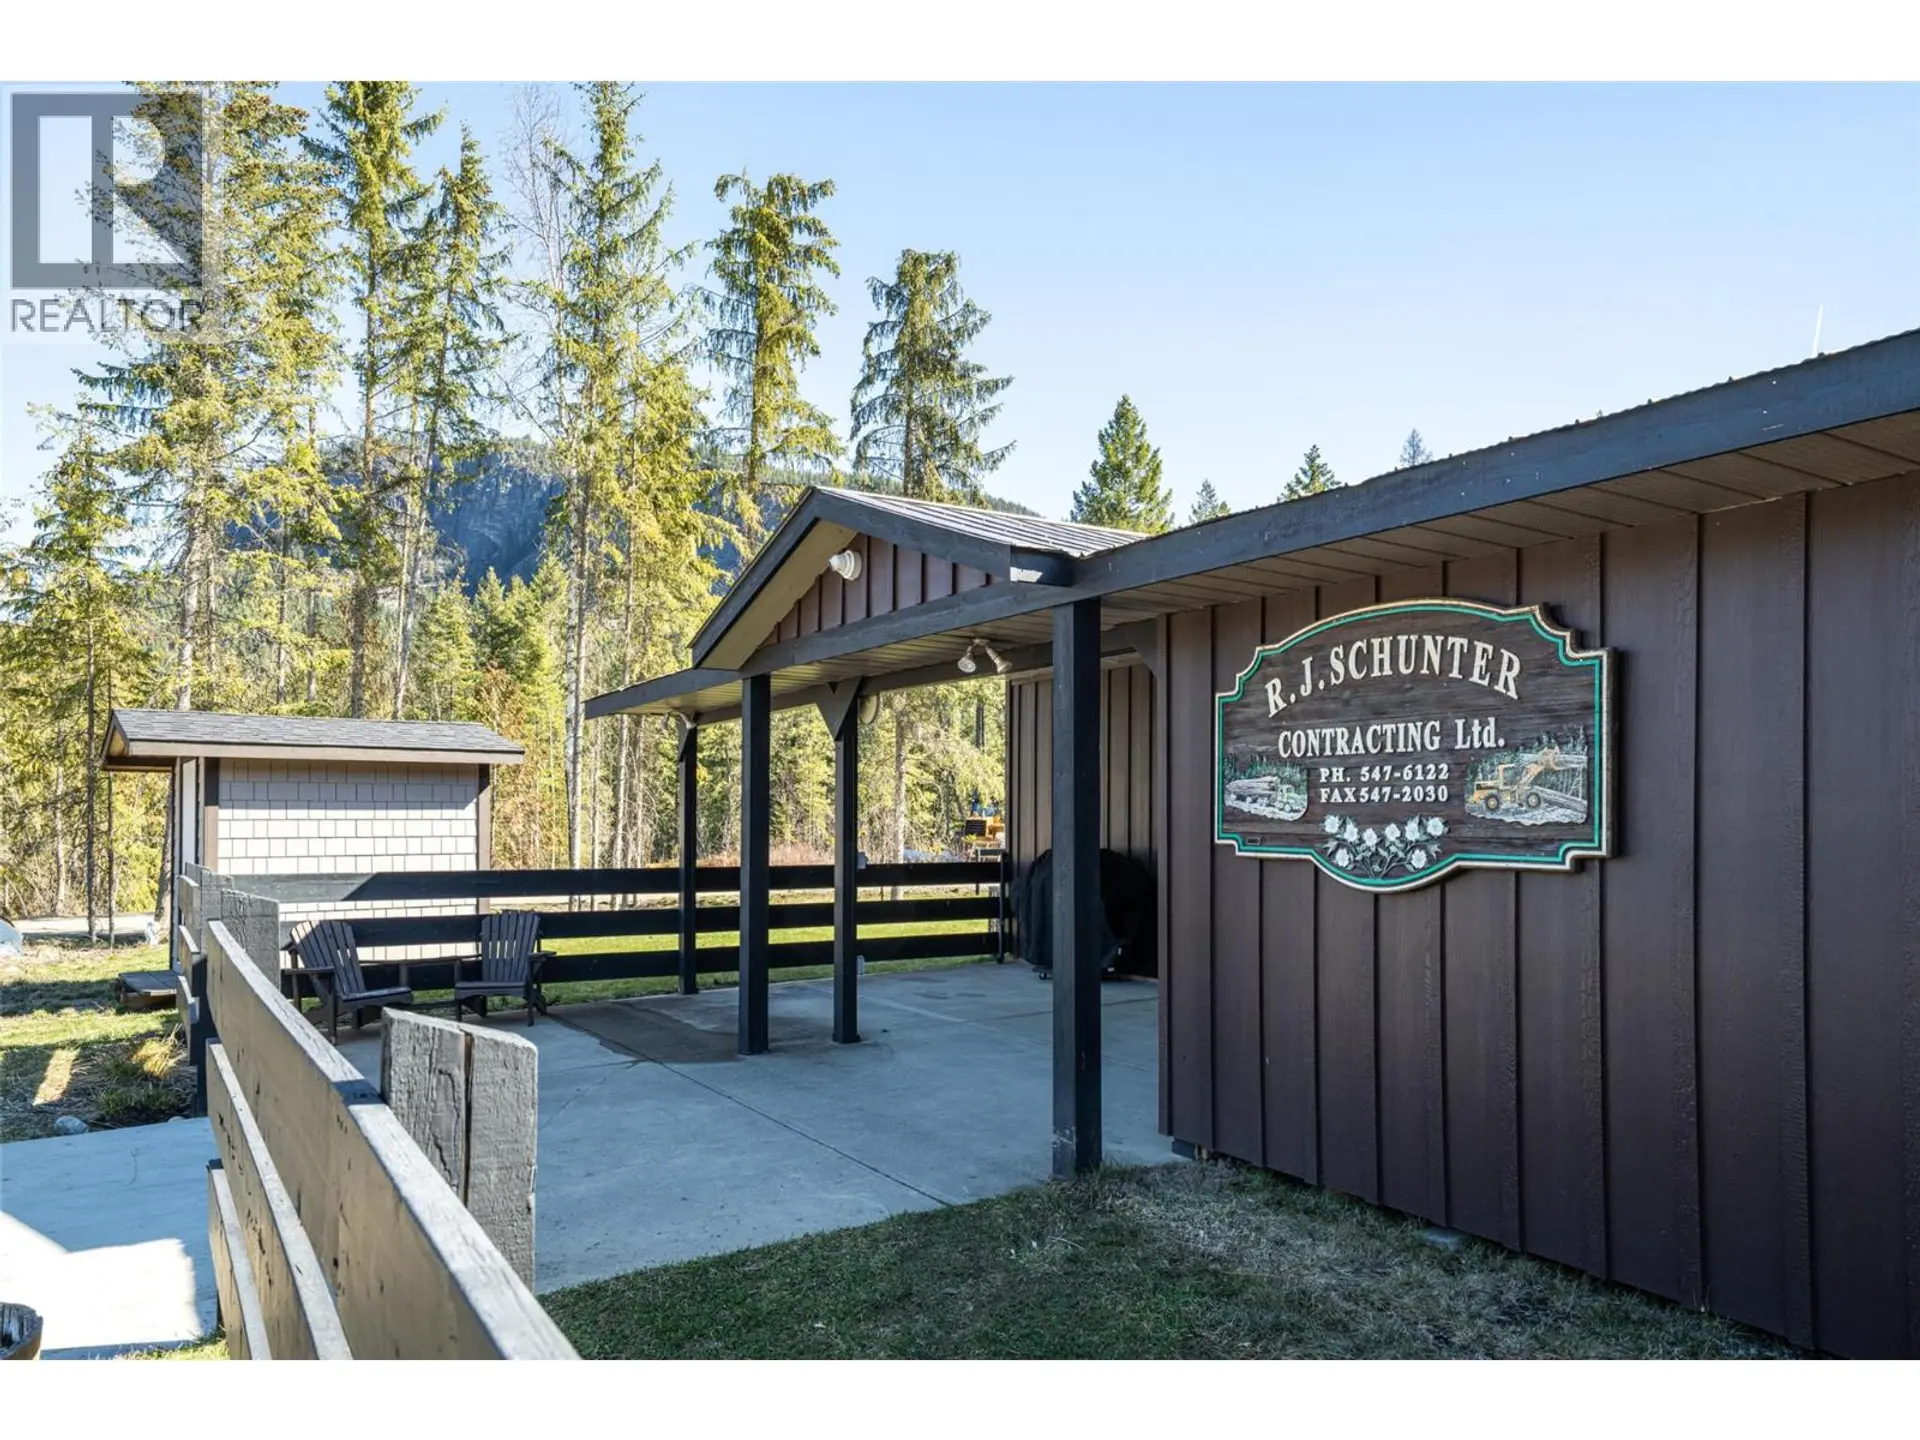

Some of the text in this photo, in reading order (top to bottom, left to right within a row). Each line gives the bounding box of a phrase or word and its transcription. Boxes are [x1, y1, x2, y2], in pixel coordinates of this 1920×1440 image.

[1277, 716, 1506, 759] CONTRACTING Ltd.
[1319, 763, 1450, 783] PH. 547-6122
